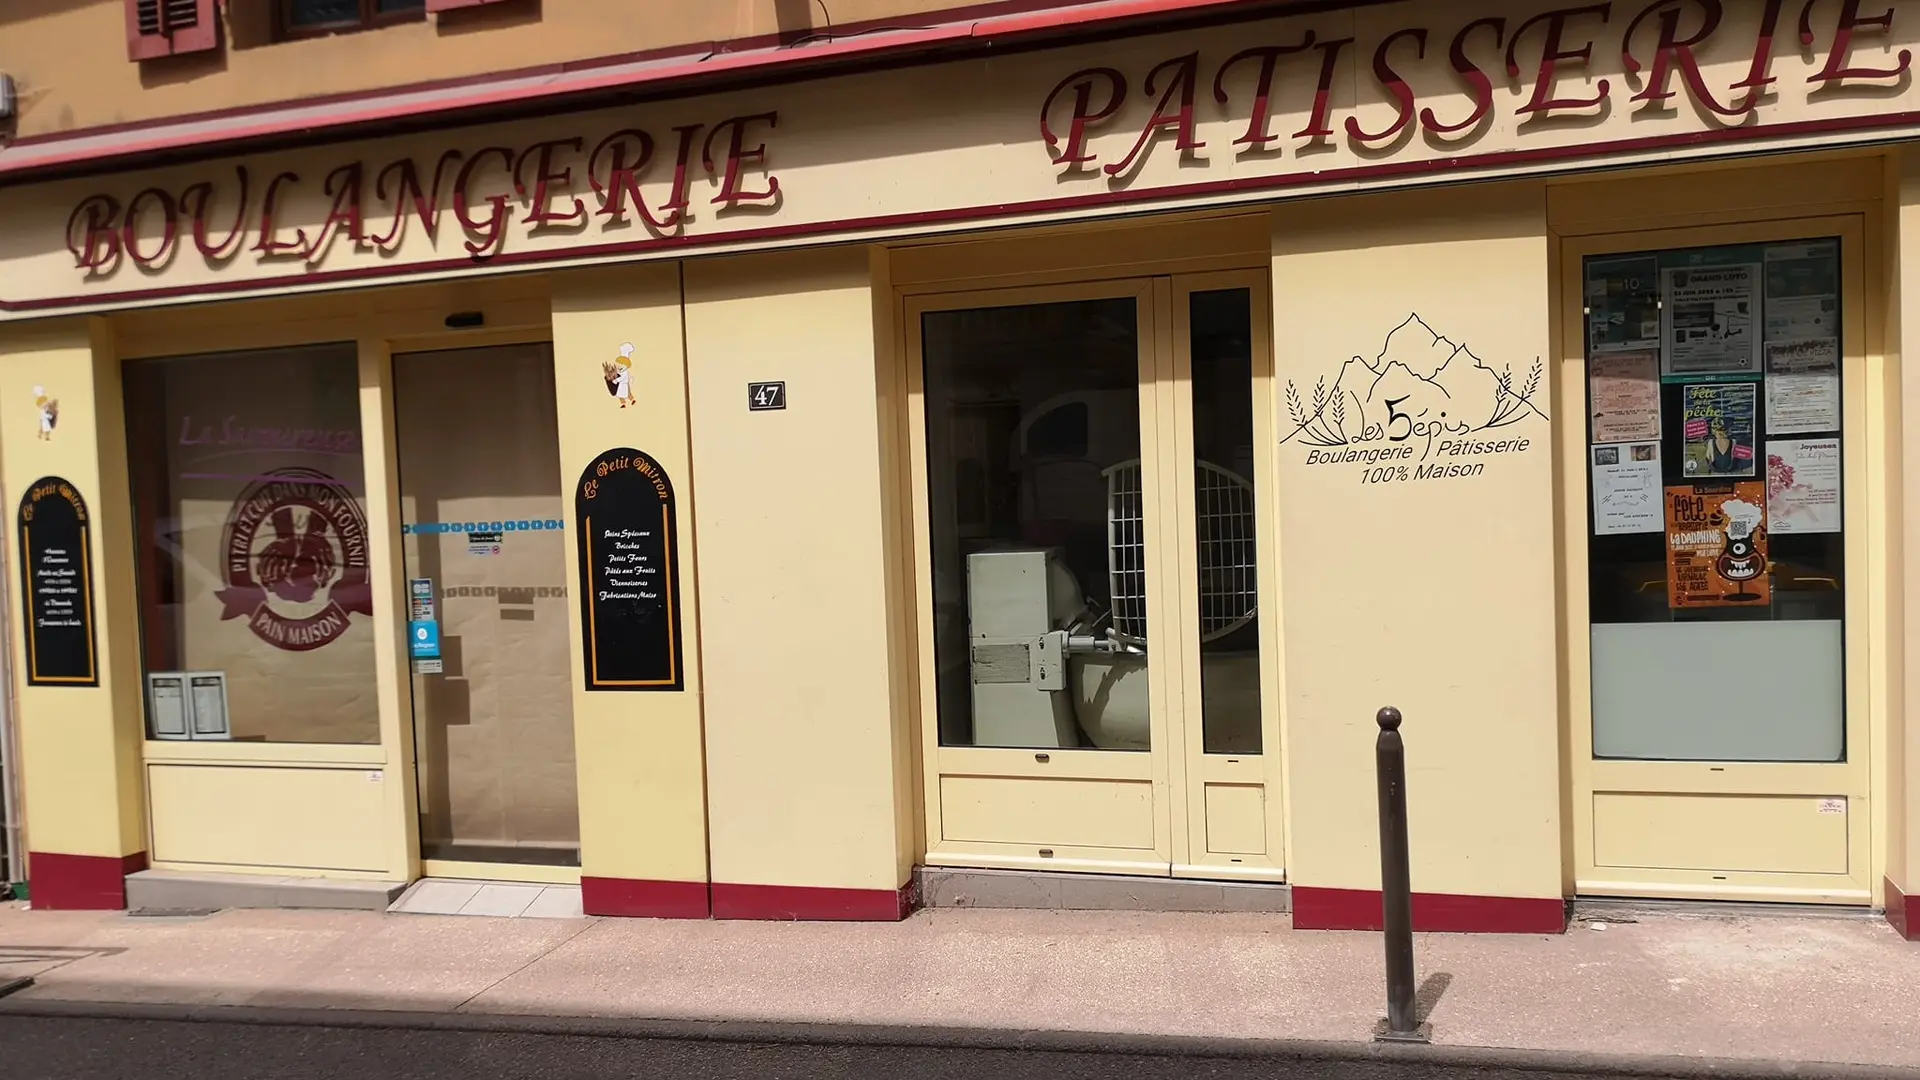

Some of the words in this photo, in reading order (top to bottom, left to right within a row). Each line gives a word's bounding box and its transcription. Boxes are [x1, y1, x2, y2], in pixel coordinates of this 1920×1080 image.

[1041, 0, 1911, 175] PATISSERIE
[66, 111, 780, 254] BOULANGERIE
[755, 385, 779, 406] 47
[1689, 387, 1717, 399] Fête
[1350, 390, 1384, 443] Les
[1384, 394, 1413, 442] 5
[1413, 407, 1472, 461] épis
[1685, 405, 1721, 421] pêche
[1306, 443, 1413, 466] Boulangerie
[1436, 436, 1530, 458] Pâtisserie
[1800, 443, 1837, 452] Joyeuses
[596, 455, 629, 477] Petit
[632, 456, 669, 499] Mitron
[1360, 467, 1409, 485] 100%
[1414, 462, 1484, 481] Maison
[255, 612, 285, 643] PAIN
[288, 611, 343, 646] MAISON
